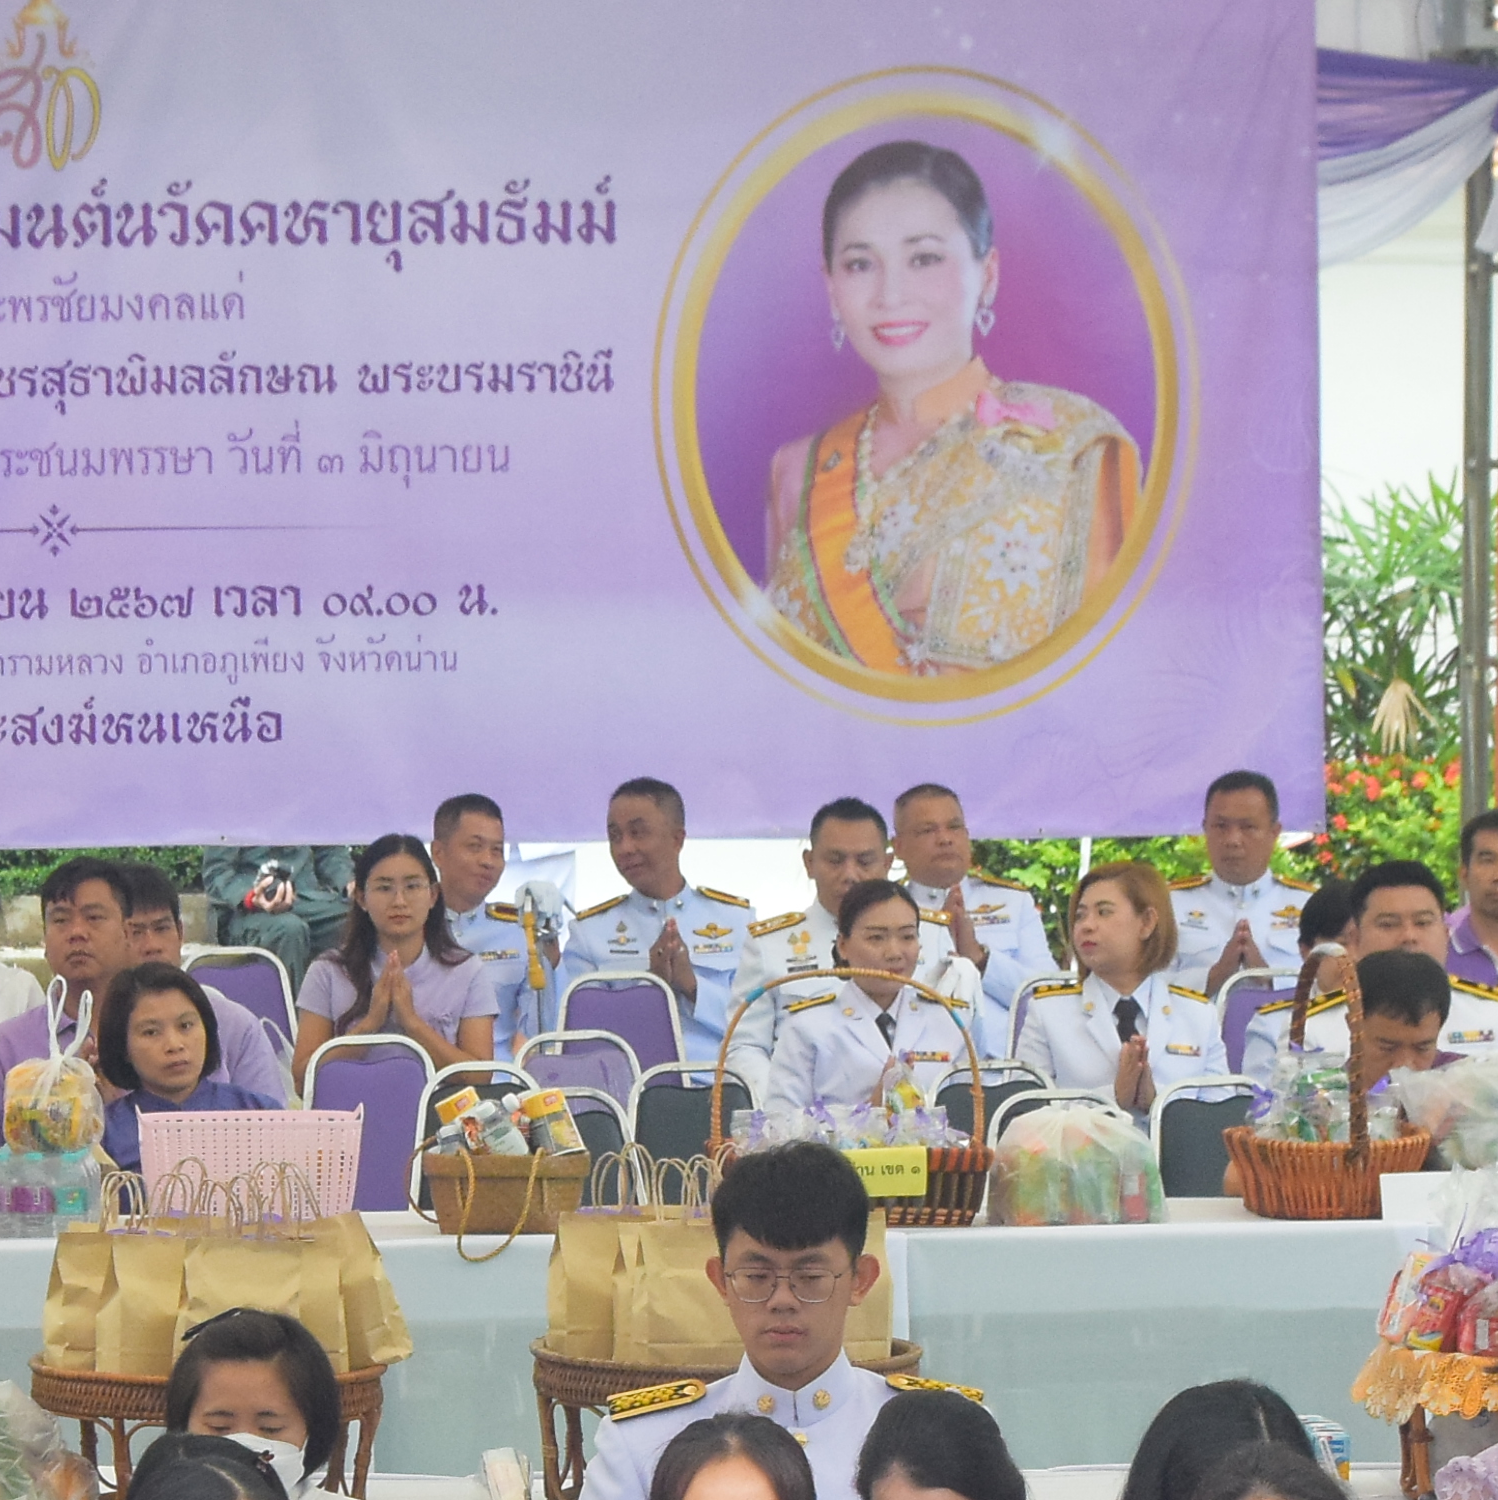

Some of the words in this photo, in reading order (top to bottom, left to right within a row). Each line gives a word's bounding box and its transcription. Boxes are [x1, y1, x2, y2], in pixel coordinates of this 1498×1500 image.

[359, 349, 615, 396] พระบรมราชินี
[228, 420, 302, 475] วันที่
[317, 451, 344, 474] ๓
[359, 429, 511, 488] มิถุนายน
[69, 584, 194, 619] ๒๕๖๗
[214, 584, 302, 618] เวลา
[322, 584, 438, 617] ๐๙.๐๐
[458, 583, 499, 616] น.
[138, 638, 304, 686] อำเภอภูเพียง
[318, 634, 458, 674] จังหวัดน่าน
[881, 1164, 905, 1176] เขต
[910, 1165, 921, 1175] ๑
